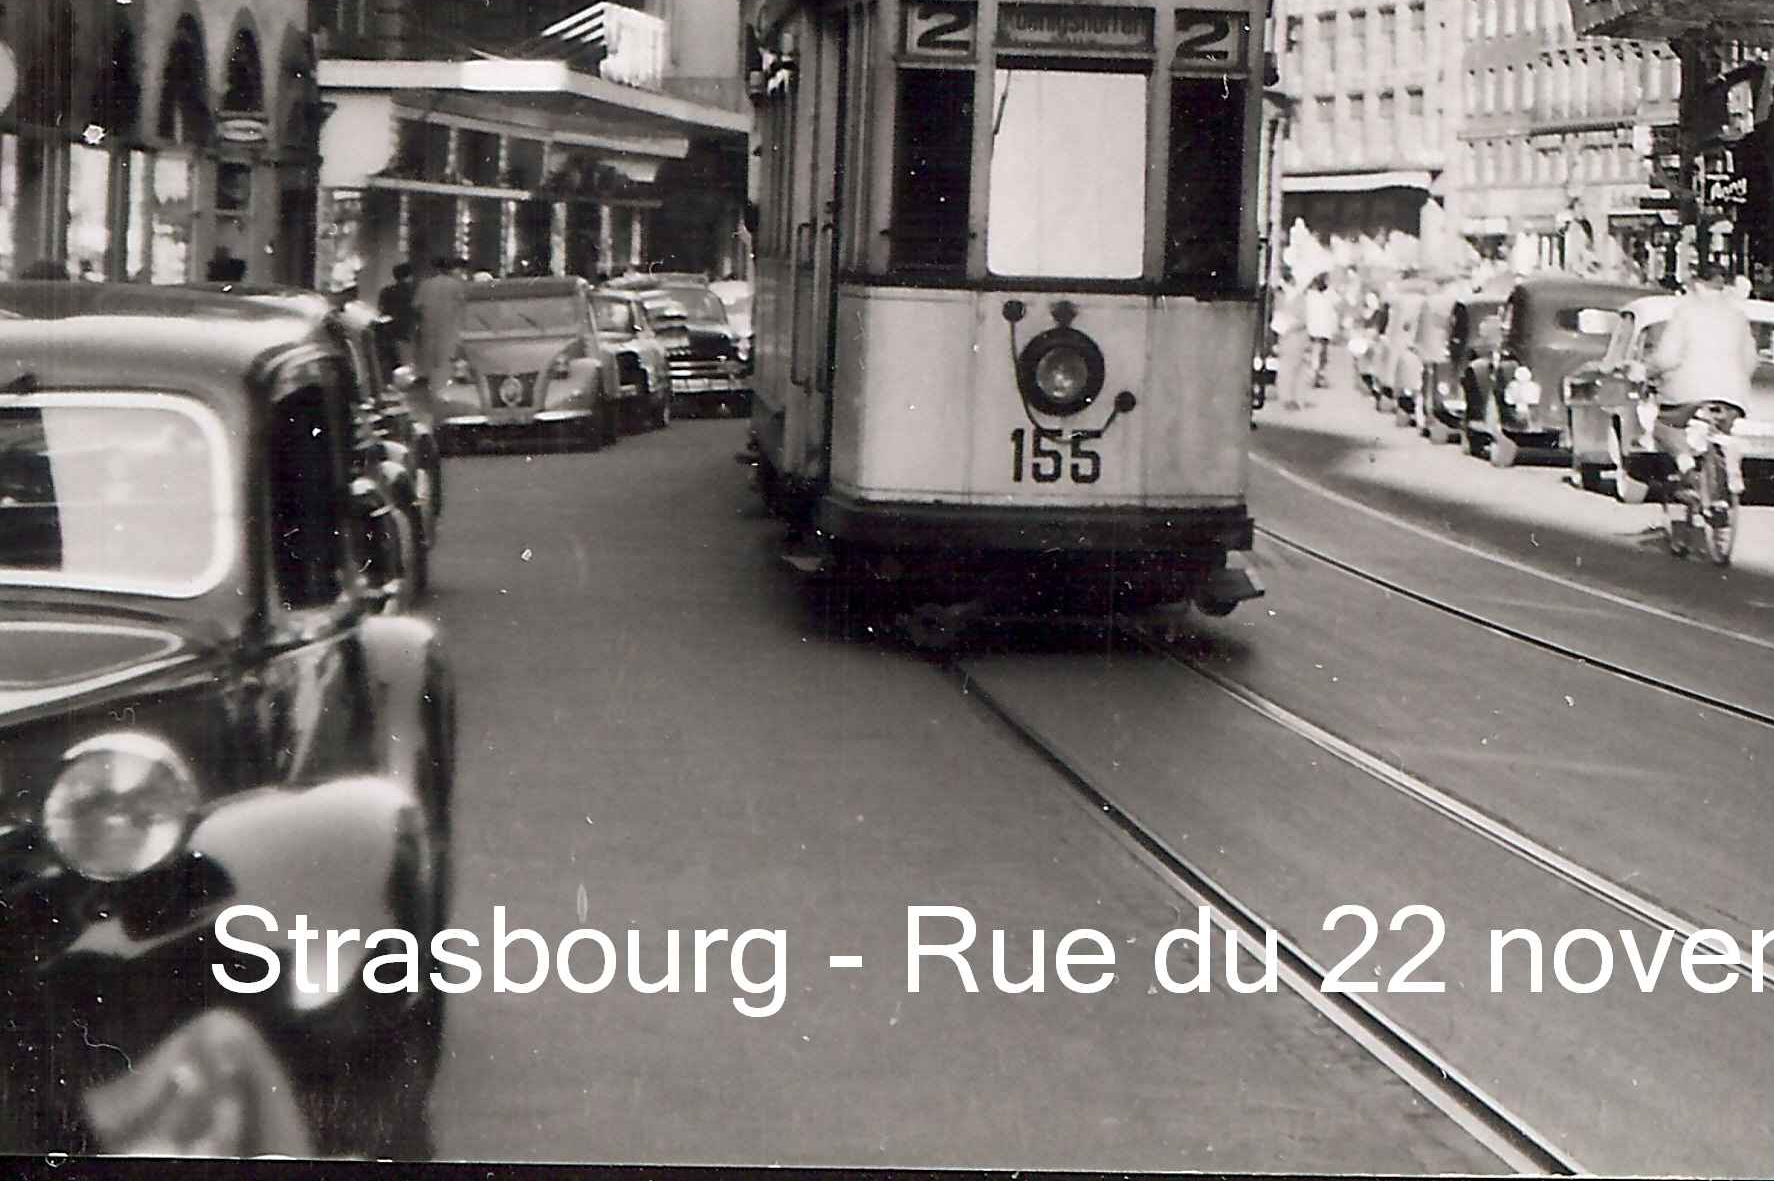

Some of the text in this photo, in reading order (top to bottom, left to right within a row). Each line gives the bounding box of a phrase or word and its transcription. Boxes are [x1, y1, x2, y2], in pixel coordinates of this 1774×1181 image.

[916, 4, 971, 51] 2
[1176, 16, 1230, 61] 2
[1010, 428, 1103, 484] 155
